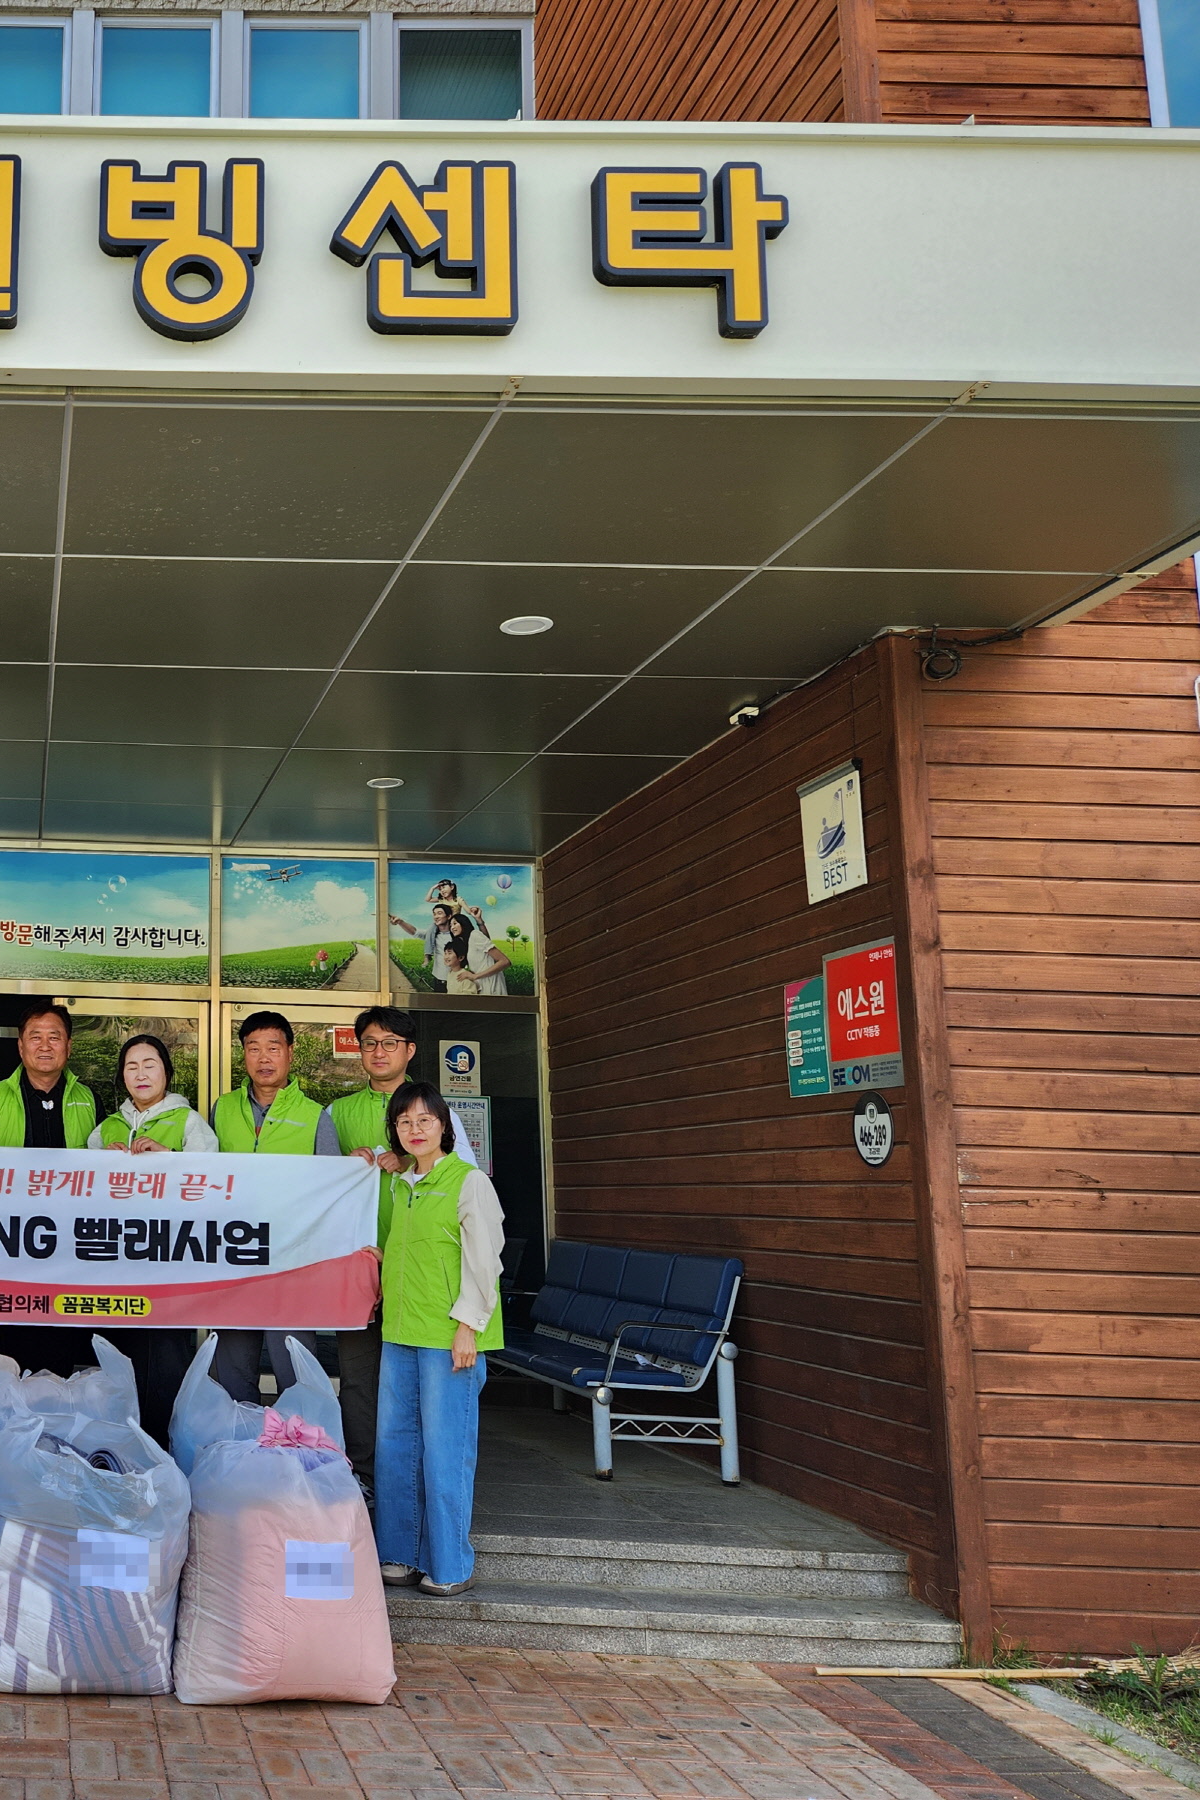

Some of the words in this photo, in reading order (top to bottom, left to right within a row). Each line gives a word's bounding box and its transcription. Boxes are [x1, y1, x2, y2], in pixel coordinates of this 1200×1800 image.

[823, 862, 848, 889] BEST
[0, 921, 105, 949] 방문해주셔서
[113, 926, 206, 948] 감사합니다.
[837, 980, 885, 1021] 에스원
[846, 1028, 863, 1041] CCTV
[863, 1025, 880, 1038] 작동중
[833, 1064, 870, 1086] SECOM
[860, 1124, 887, 1146] 466-289
[28, 1169, 95, 1197] 밝게!
[108, 1171, 167, 1200] 빨래
[179, 1173, 234, 1201] 끝~!
[74, 1217, 270, 1265] 빨래사업
[62, 1296, 146, 1316] 꼼꼼복지단
